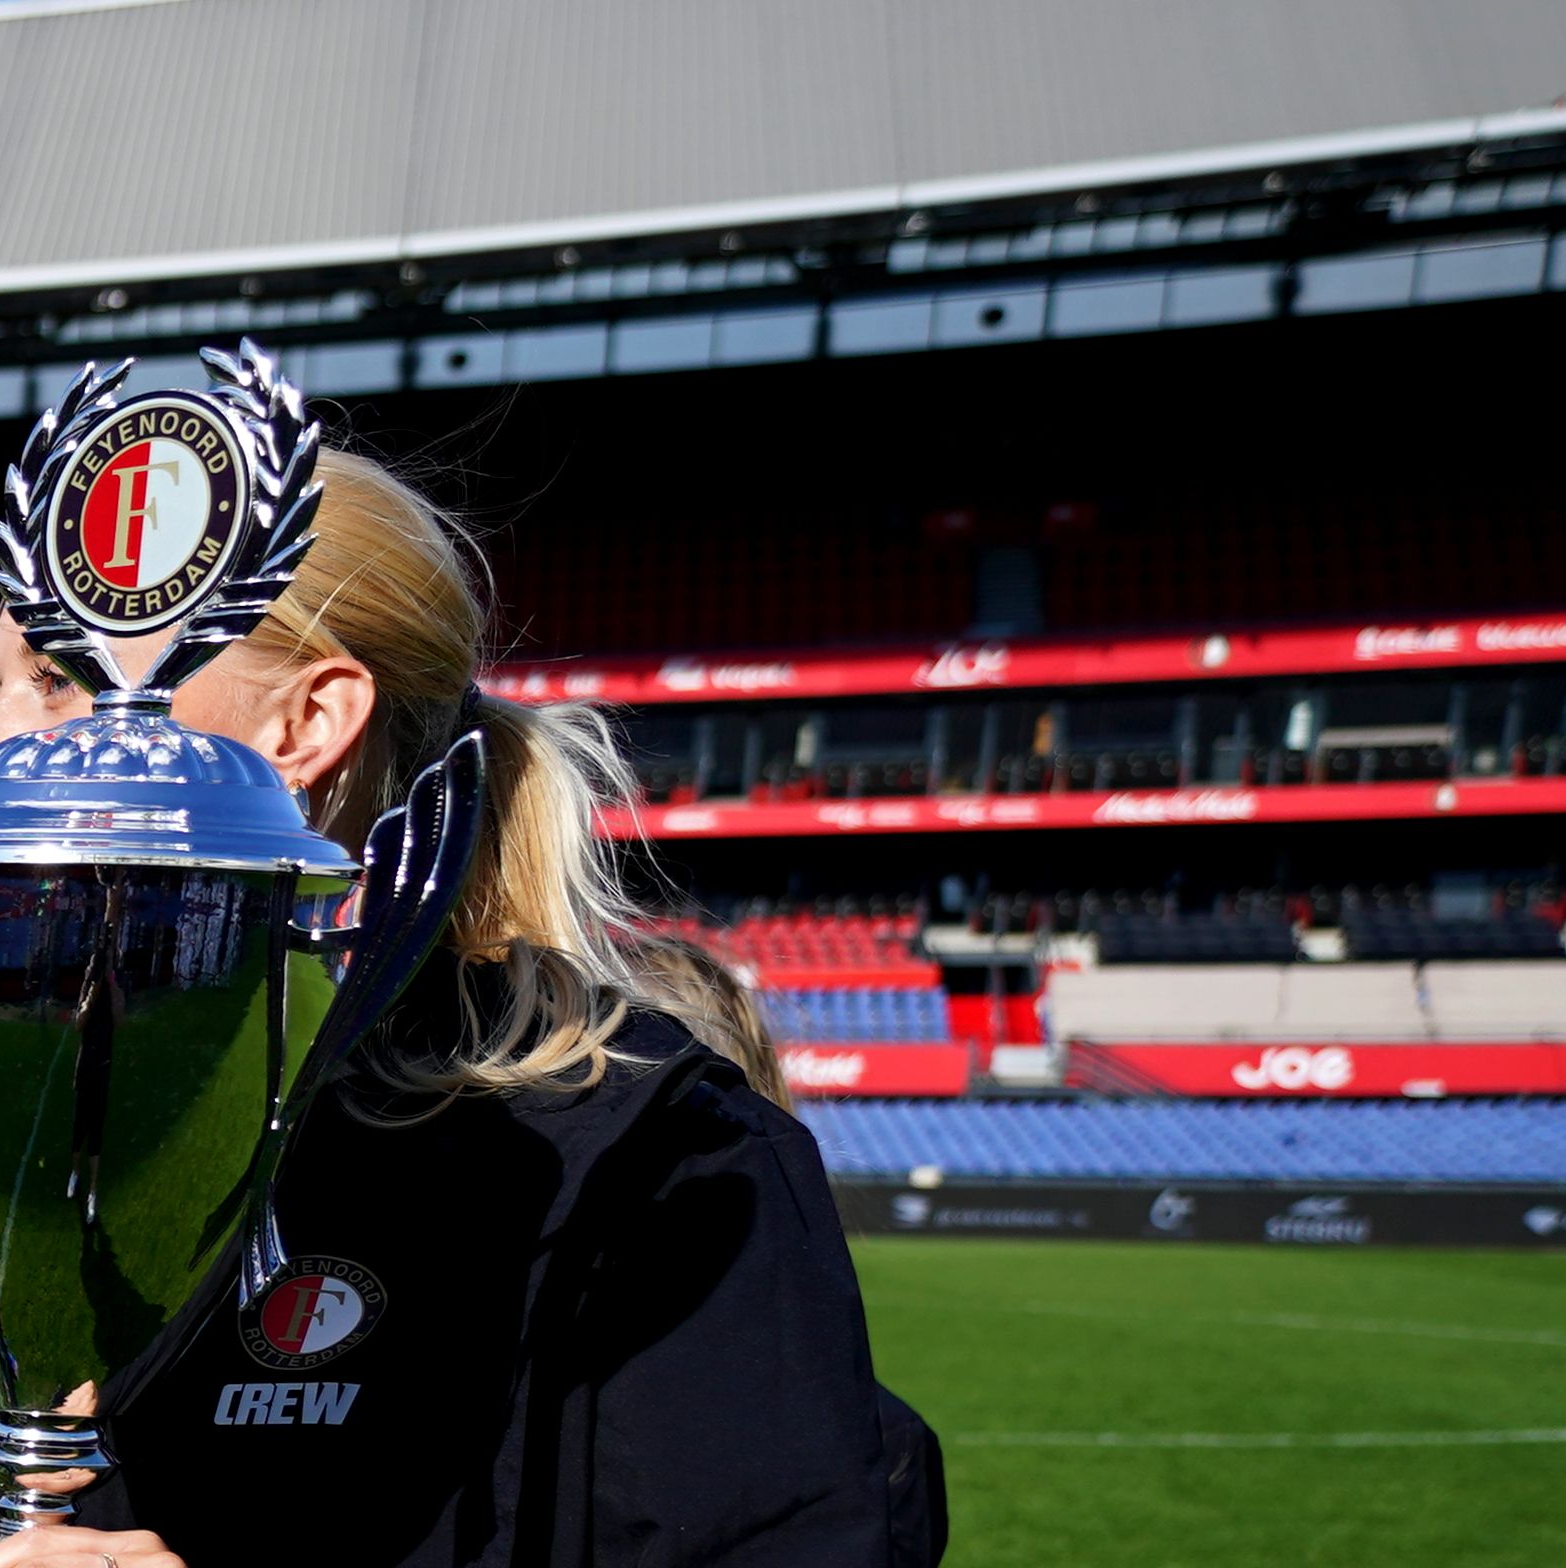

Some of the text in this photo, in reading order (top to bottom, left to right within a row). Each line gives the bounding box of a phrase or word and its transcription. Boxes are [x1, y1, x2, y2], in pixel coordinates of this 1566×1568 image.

[70, 411, 229, 492] FEYENOORD
[103, 460, 180, 569] F
[62, 535, 223, 617] ROTTERDAM
[244, 1326, 364, 1368] ROTTERDAM
[277, 1286, 346, 1342] F
[213, 1381, 362, 1426] CREW
